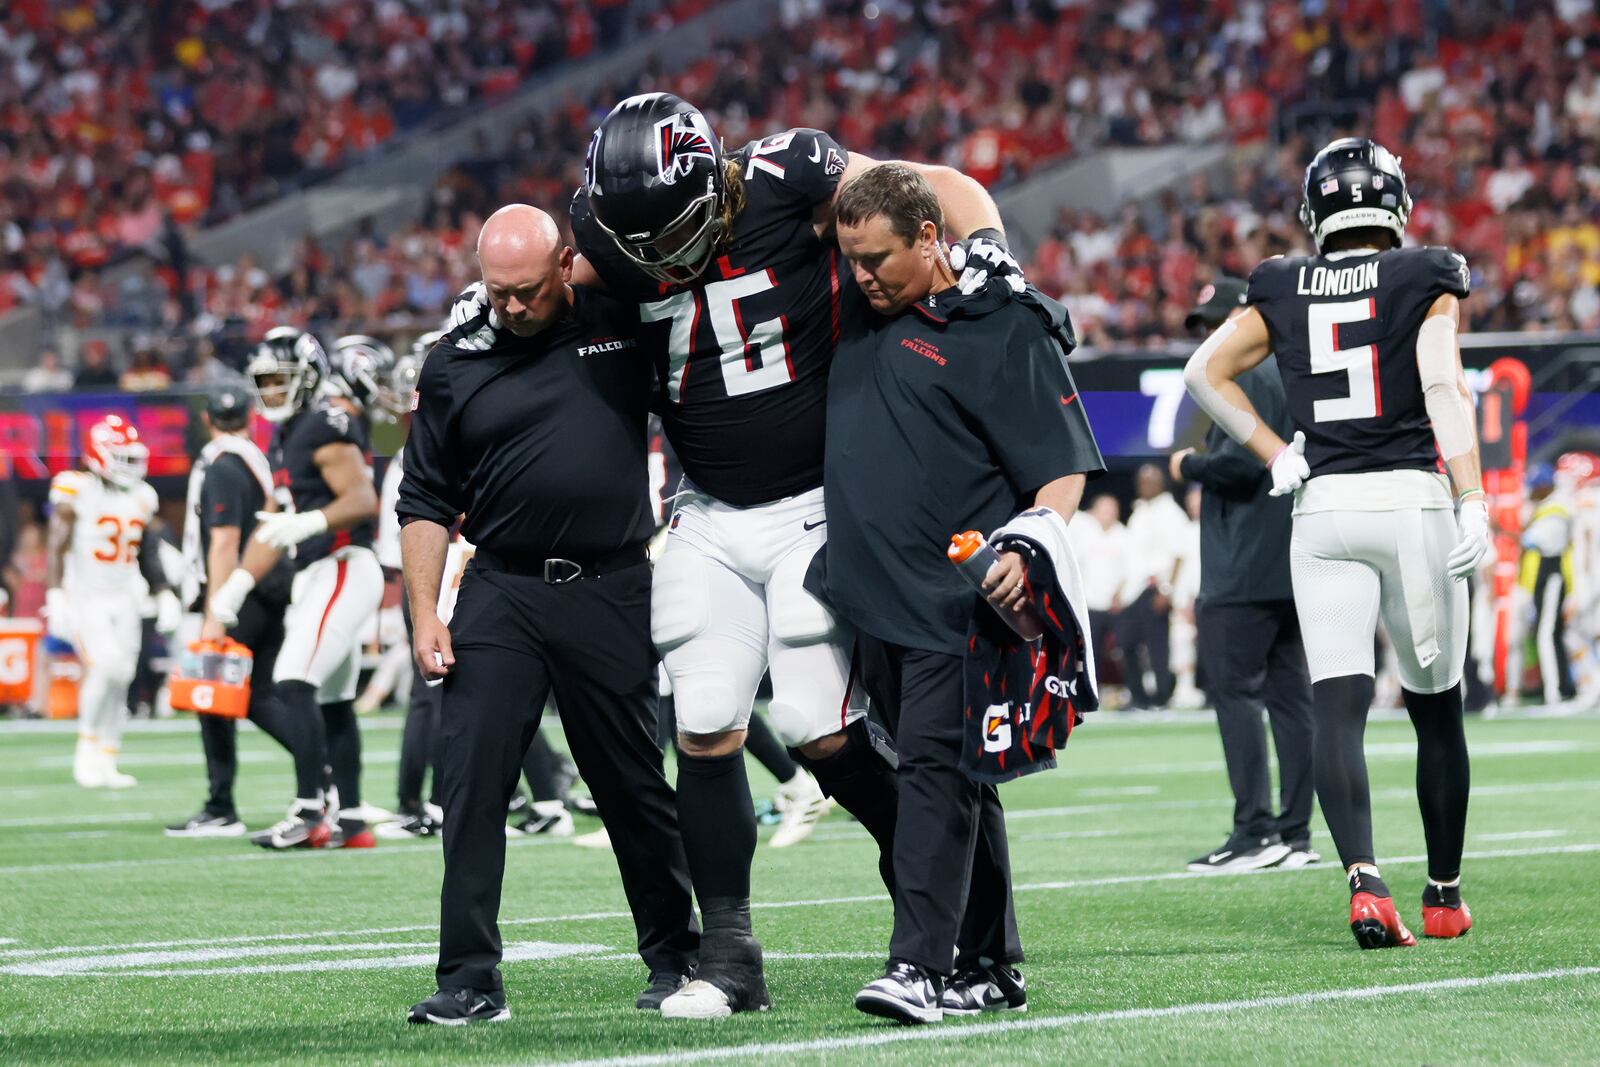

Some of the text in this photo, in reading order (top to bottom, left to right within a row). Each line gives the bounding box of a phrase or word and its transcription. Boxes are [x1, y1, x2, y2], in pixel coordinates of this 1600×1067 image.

[1350, 183, 1362, 203] 5
[1340, 213, 1377, 221] FALCONS
[1297, 261, 1380, 296] LONDON
[640, 267, 796, 404] 76
[900, 338, 948, 366] FALCONS
[1308, 297, 1382, 423] 5
[982, 702, 1012, 753] G
